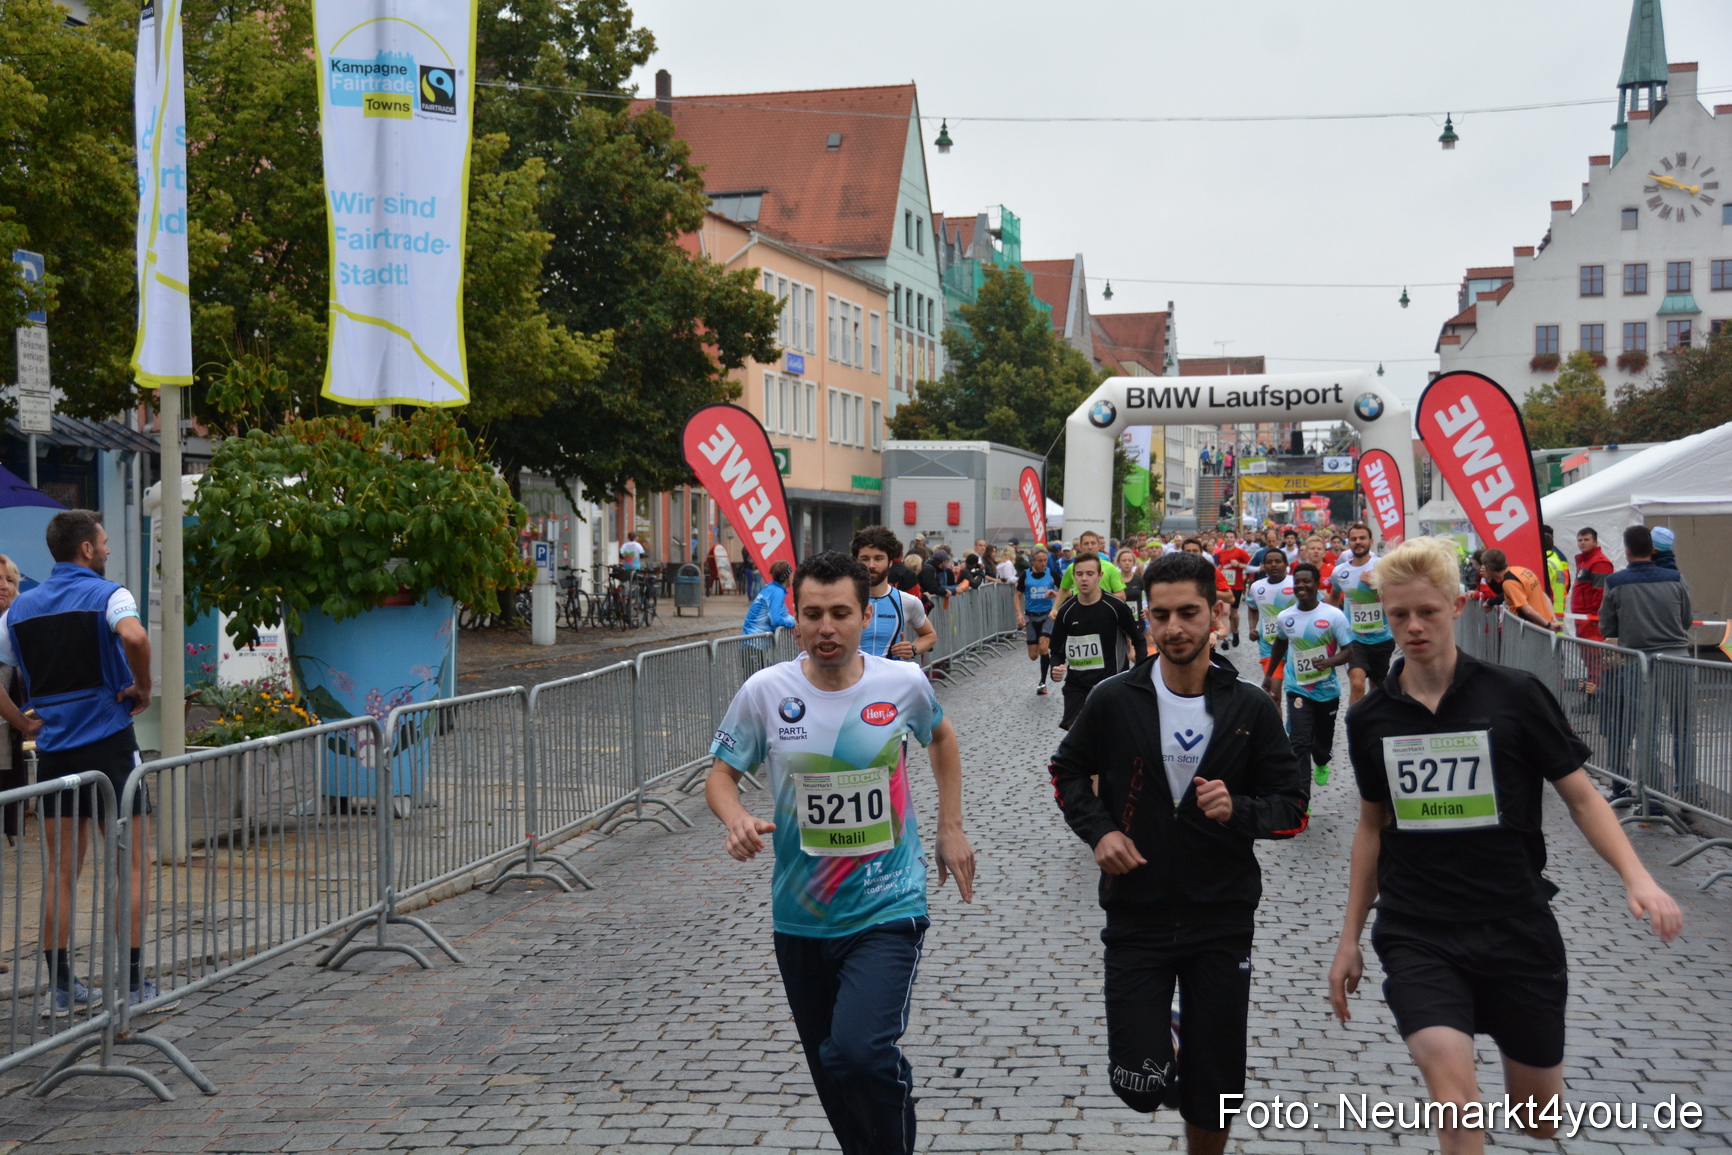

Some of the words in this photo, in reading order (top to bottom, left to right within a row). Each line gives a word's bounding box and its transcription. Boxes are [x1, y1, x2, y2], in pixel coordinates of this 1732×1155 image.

[331, 60, 408, 77] Kampagne
[332, 74, 416, 92] Fairtrade
[365, 98, 410, 112] Towns
[422, 102, 455, 114] FAIRTRADE
[330, 190, 376, 214] Wir
[383, 192, 436, 218] sind
[335, 226, 451, 255] Fairtrade-
[340, 262, 409, 286] Stadt!
[1126, 386, 1200, 409] BMW
[1208, 383, 1343, 411] Laufsport
[1284, 478, 1310, 488] ZIEL
[538, 546, 546, 558] P
[1354, 610, 1380, 622] 5219
[1068, 643, 1099, 658] 5170
[778, 726, 808, 735] PARTL
[714, 730, 736, 750] OCK
[1430, 736, 1479, 750] BOCK
[1162, 754, 1174, 762] en
[838, 770, 882, 786] BOCK
[1397, 756, 1480, 794] 5277
[808, 788, 883, 824] 5210
[1421, 802, 1464, 816] Adrian
[830, 831, 866, 845] Khalil
[1112, 1065, 1160, 1092] PUMA
